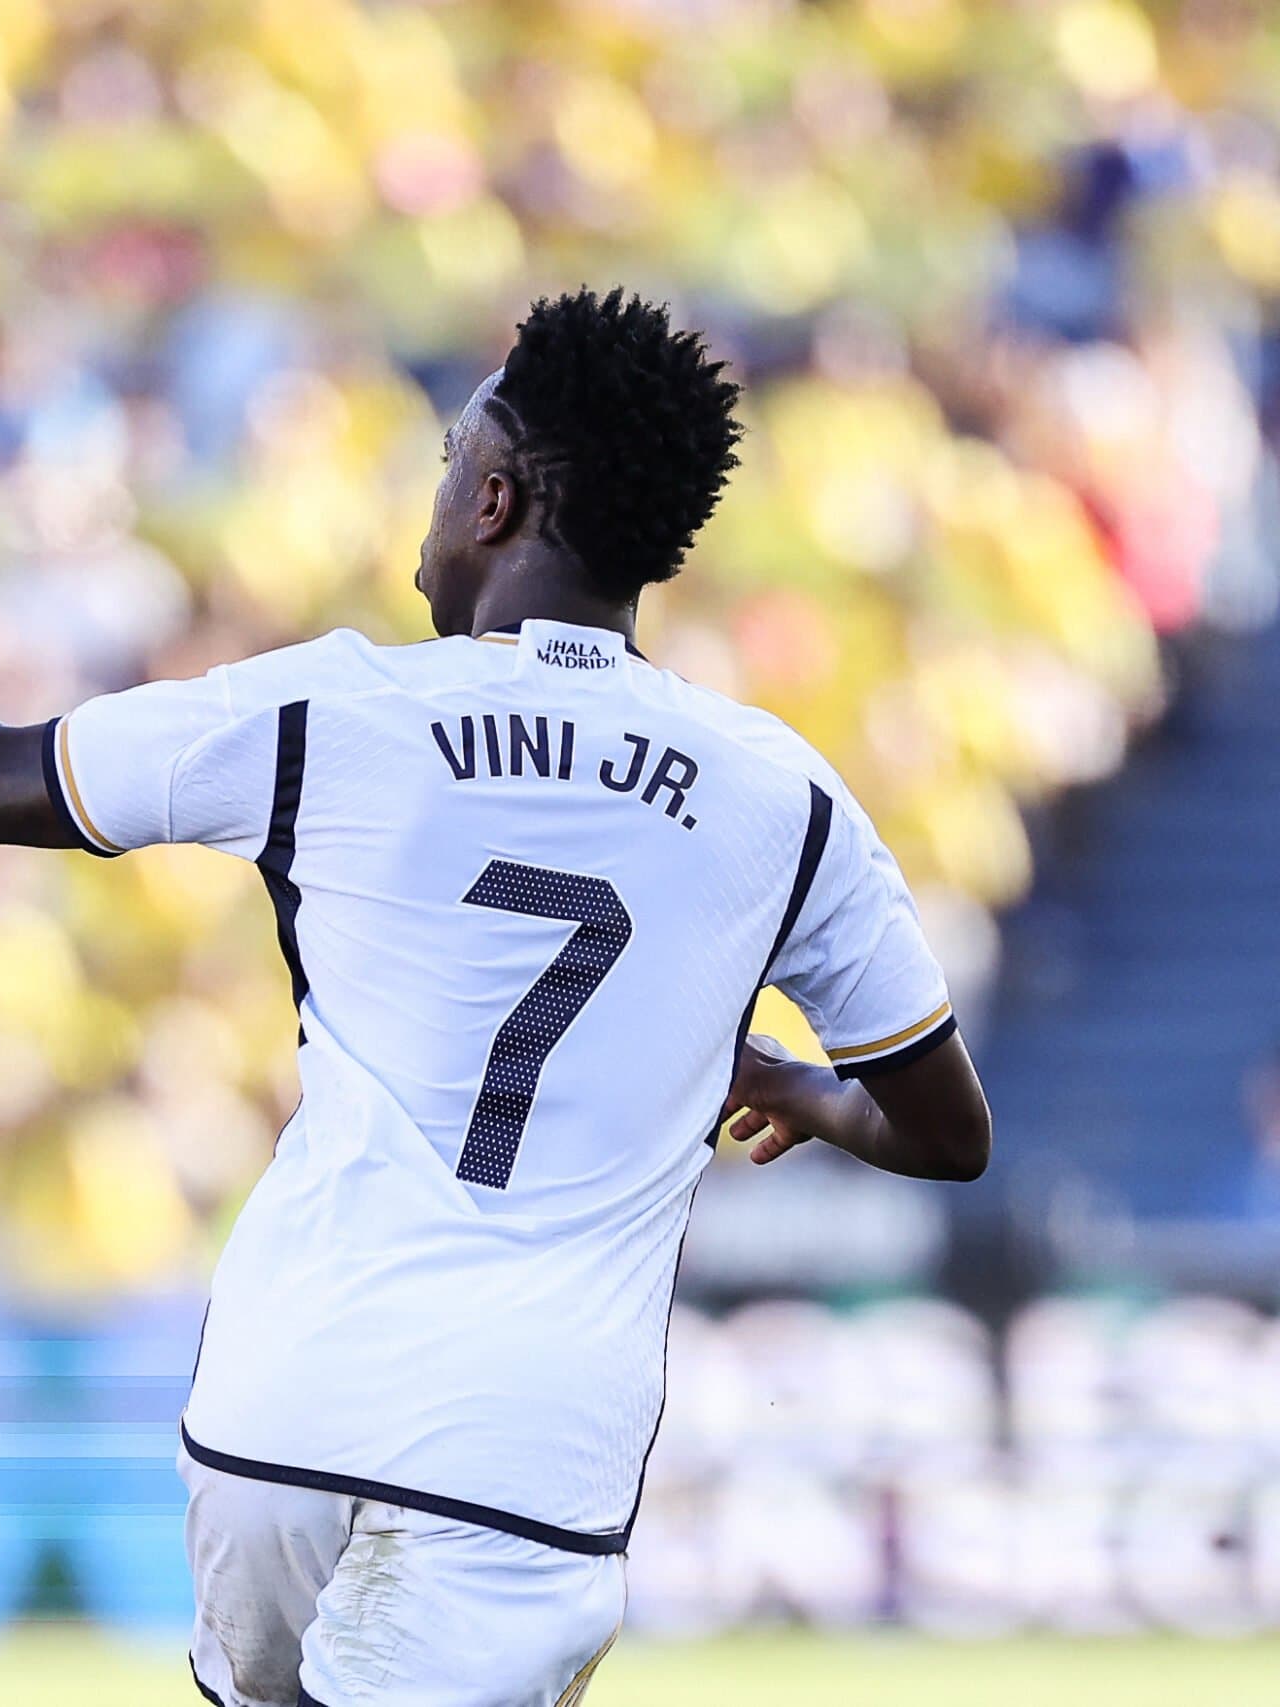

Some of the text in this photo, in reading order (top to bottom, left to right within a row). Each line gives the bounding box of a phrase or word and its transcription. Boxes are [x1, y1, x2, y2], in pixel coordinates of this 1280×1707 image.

[536, 648, 616, 670] MADRID!
[546, 639, 602, 658] ¡HALA
[429, 713, 698, 832] VINI JR.
[455, 857, 634, 1192] 7
